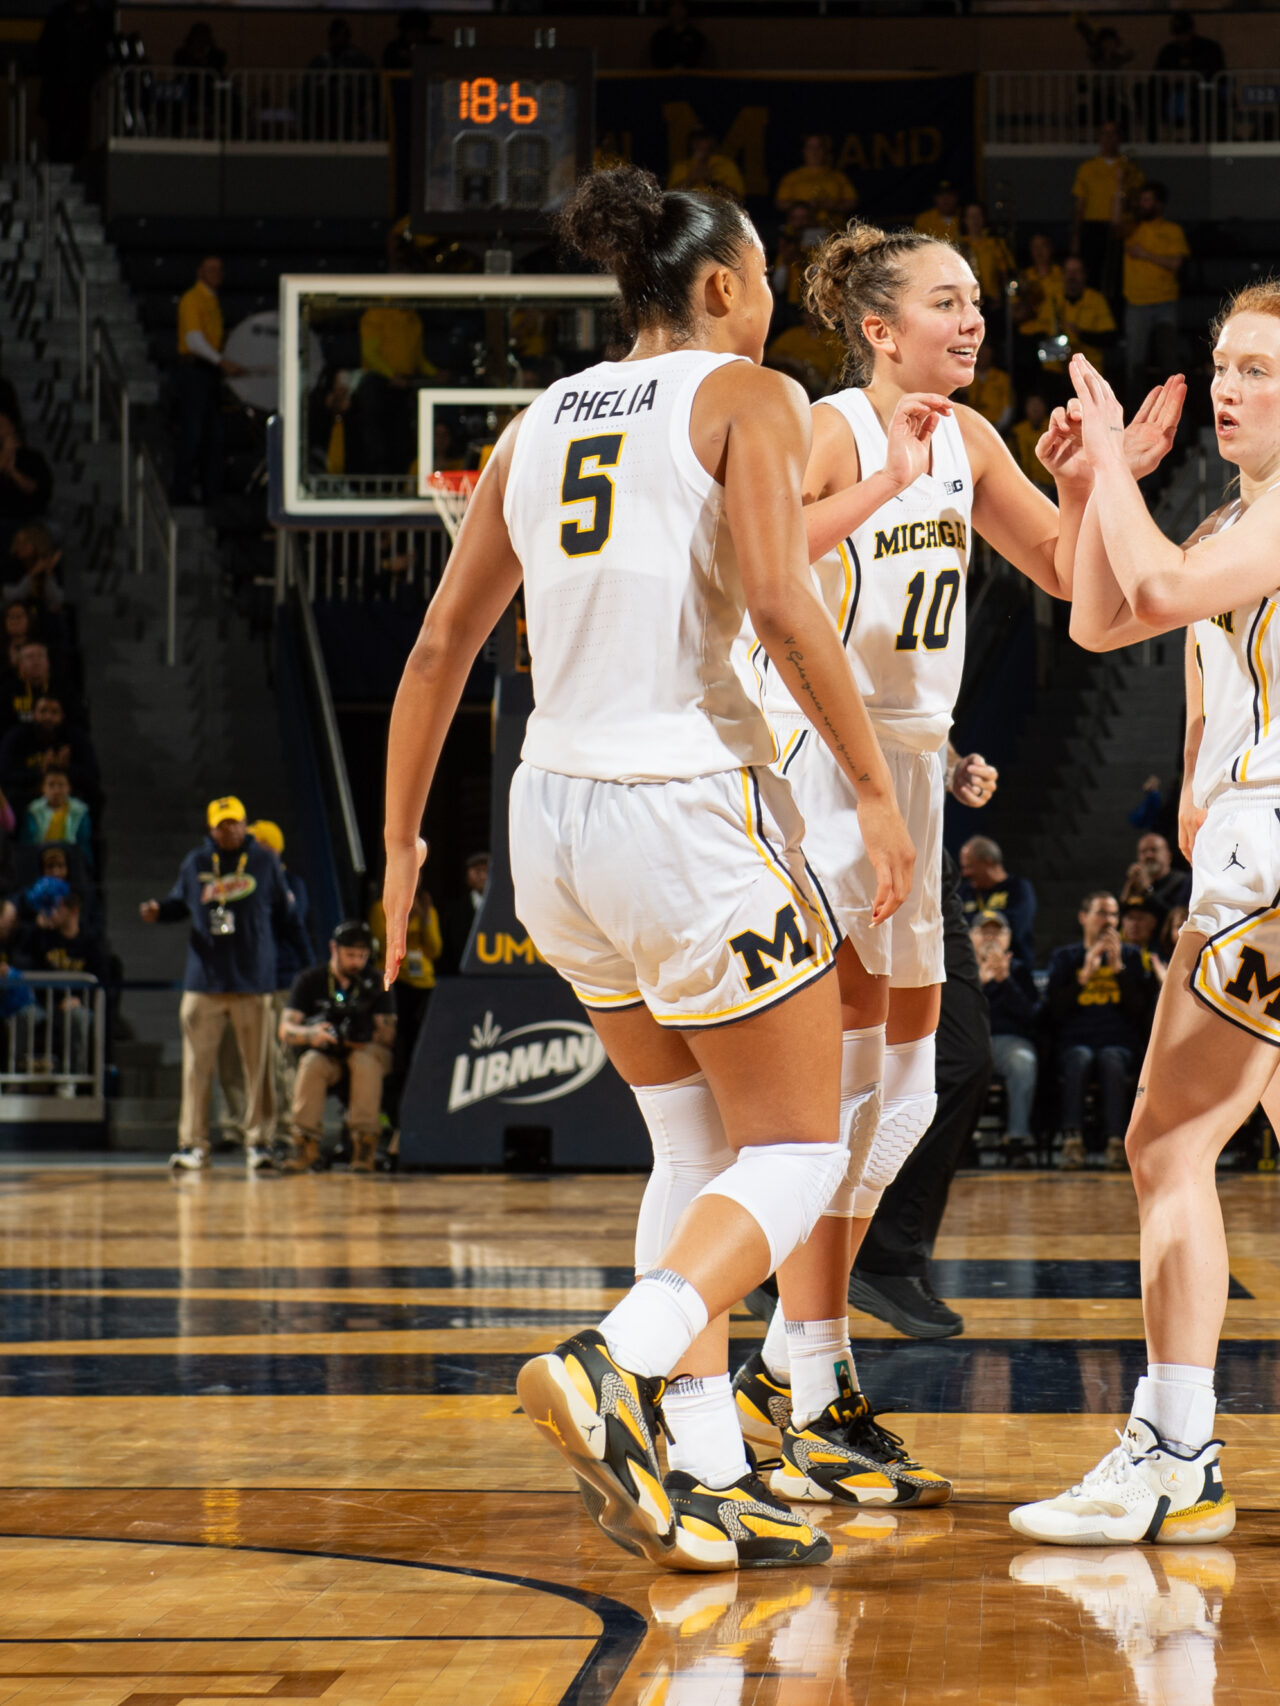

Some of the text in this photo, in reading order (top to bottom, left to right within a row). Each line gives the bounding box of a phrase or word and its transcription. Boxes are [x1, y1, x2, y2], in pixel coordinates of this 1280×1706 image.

[554, 379, 658, 424] PHELIA
[558, 431, 628, 559] 5
[894, 567, 962, 652] 10
[477, 932, 548, 965] UM
[727, 901, 817, 993] M
[448, 1033, 593, 1114] LIBMAN
